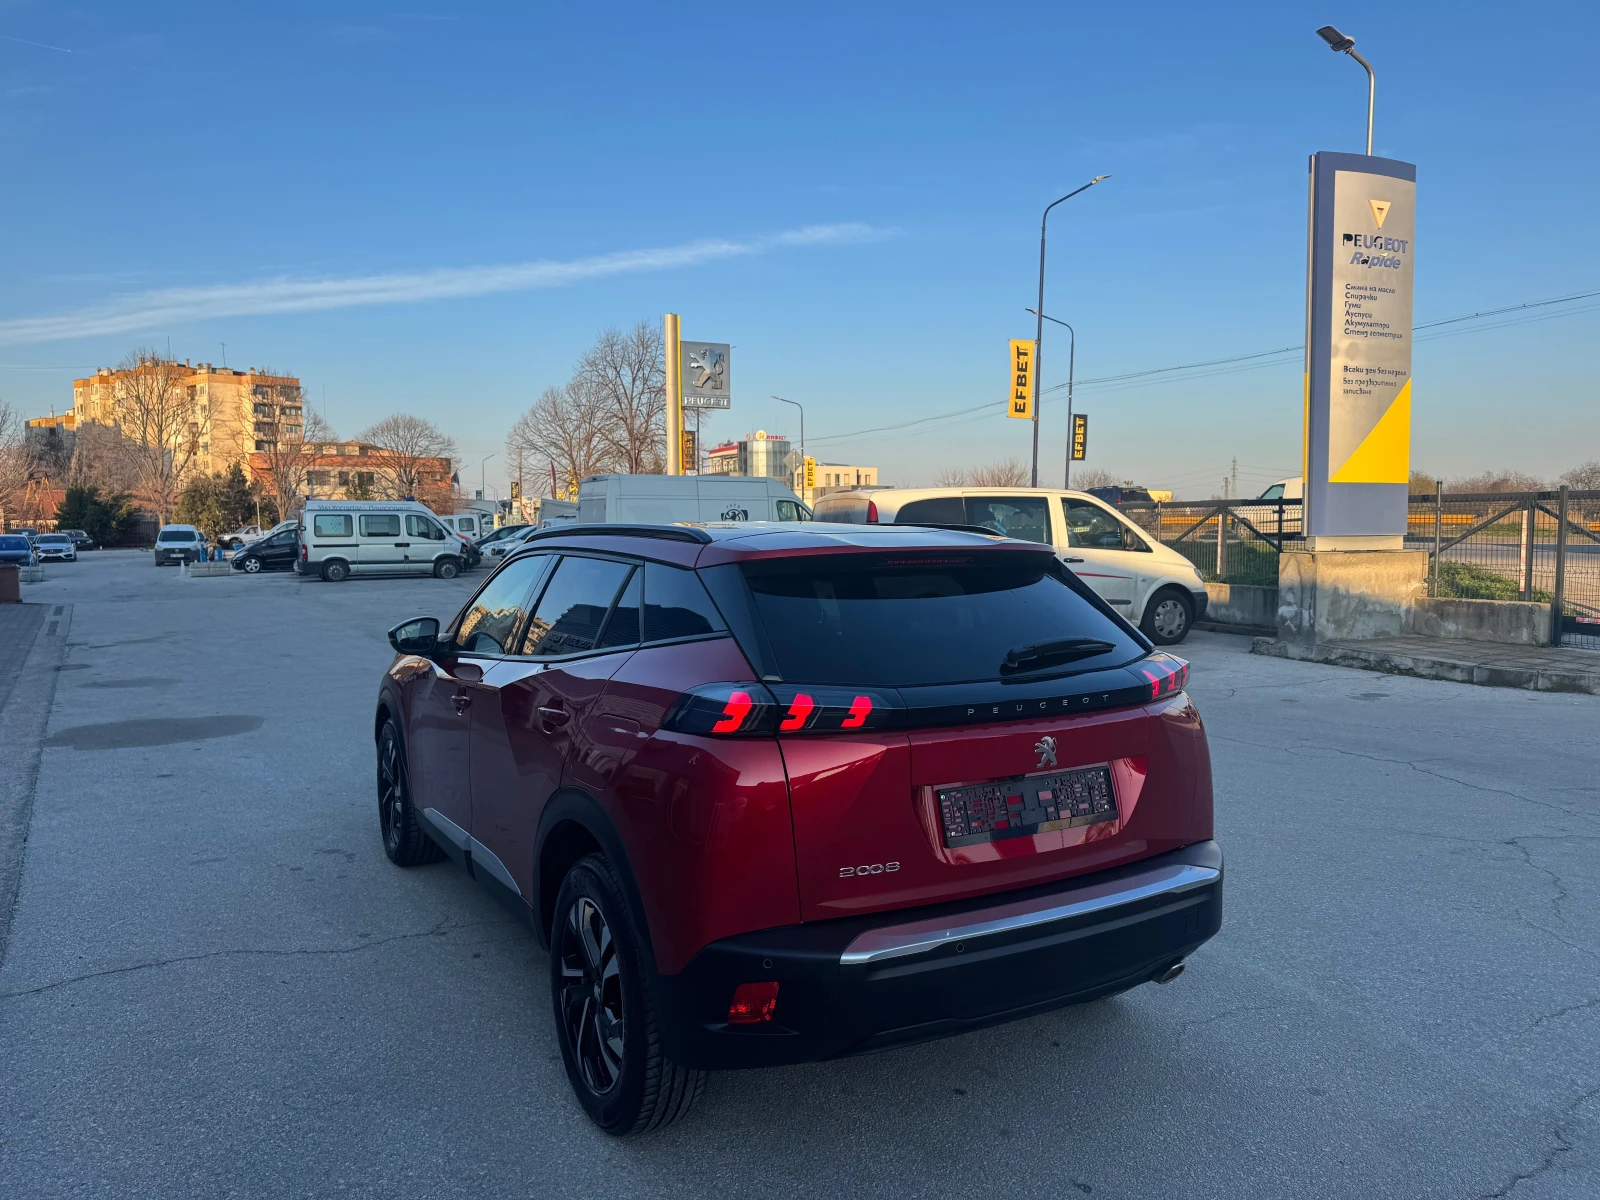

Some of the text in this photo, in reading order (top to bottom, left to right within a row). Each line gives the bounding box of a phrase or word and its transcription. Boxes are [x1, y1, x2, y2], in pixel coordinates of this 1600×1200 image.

[1343, 233, 1408, 253] PEUGEOT
[1350, 251, 1401, 269] Rapide
[1345, 292, 1377, 301] Спирачки
[1345, 301, 1361, 309] Гуми
[1345, 310, 1372, 319] Ауспуси
[1345, 319, 1390, 330] Акумулатори
[1343, 365, 1364, 373] Всеки
[1014, 346, 1028, 413] EFBET
[684, 396, 729, 406] PEUGEOT
[1074, 417, 1084, 459] EFBET
[967, 694, 1109, 715] PEUGEOT
[839, 861, 900, 878] 2008
